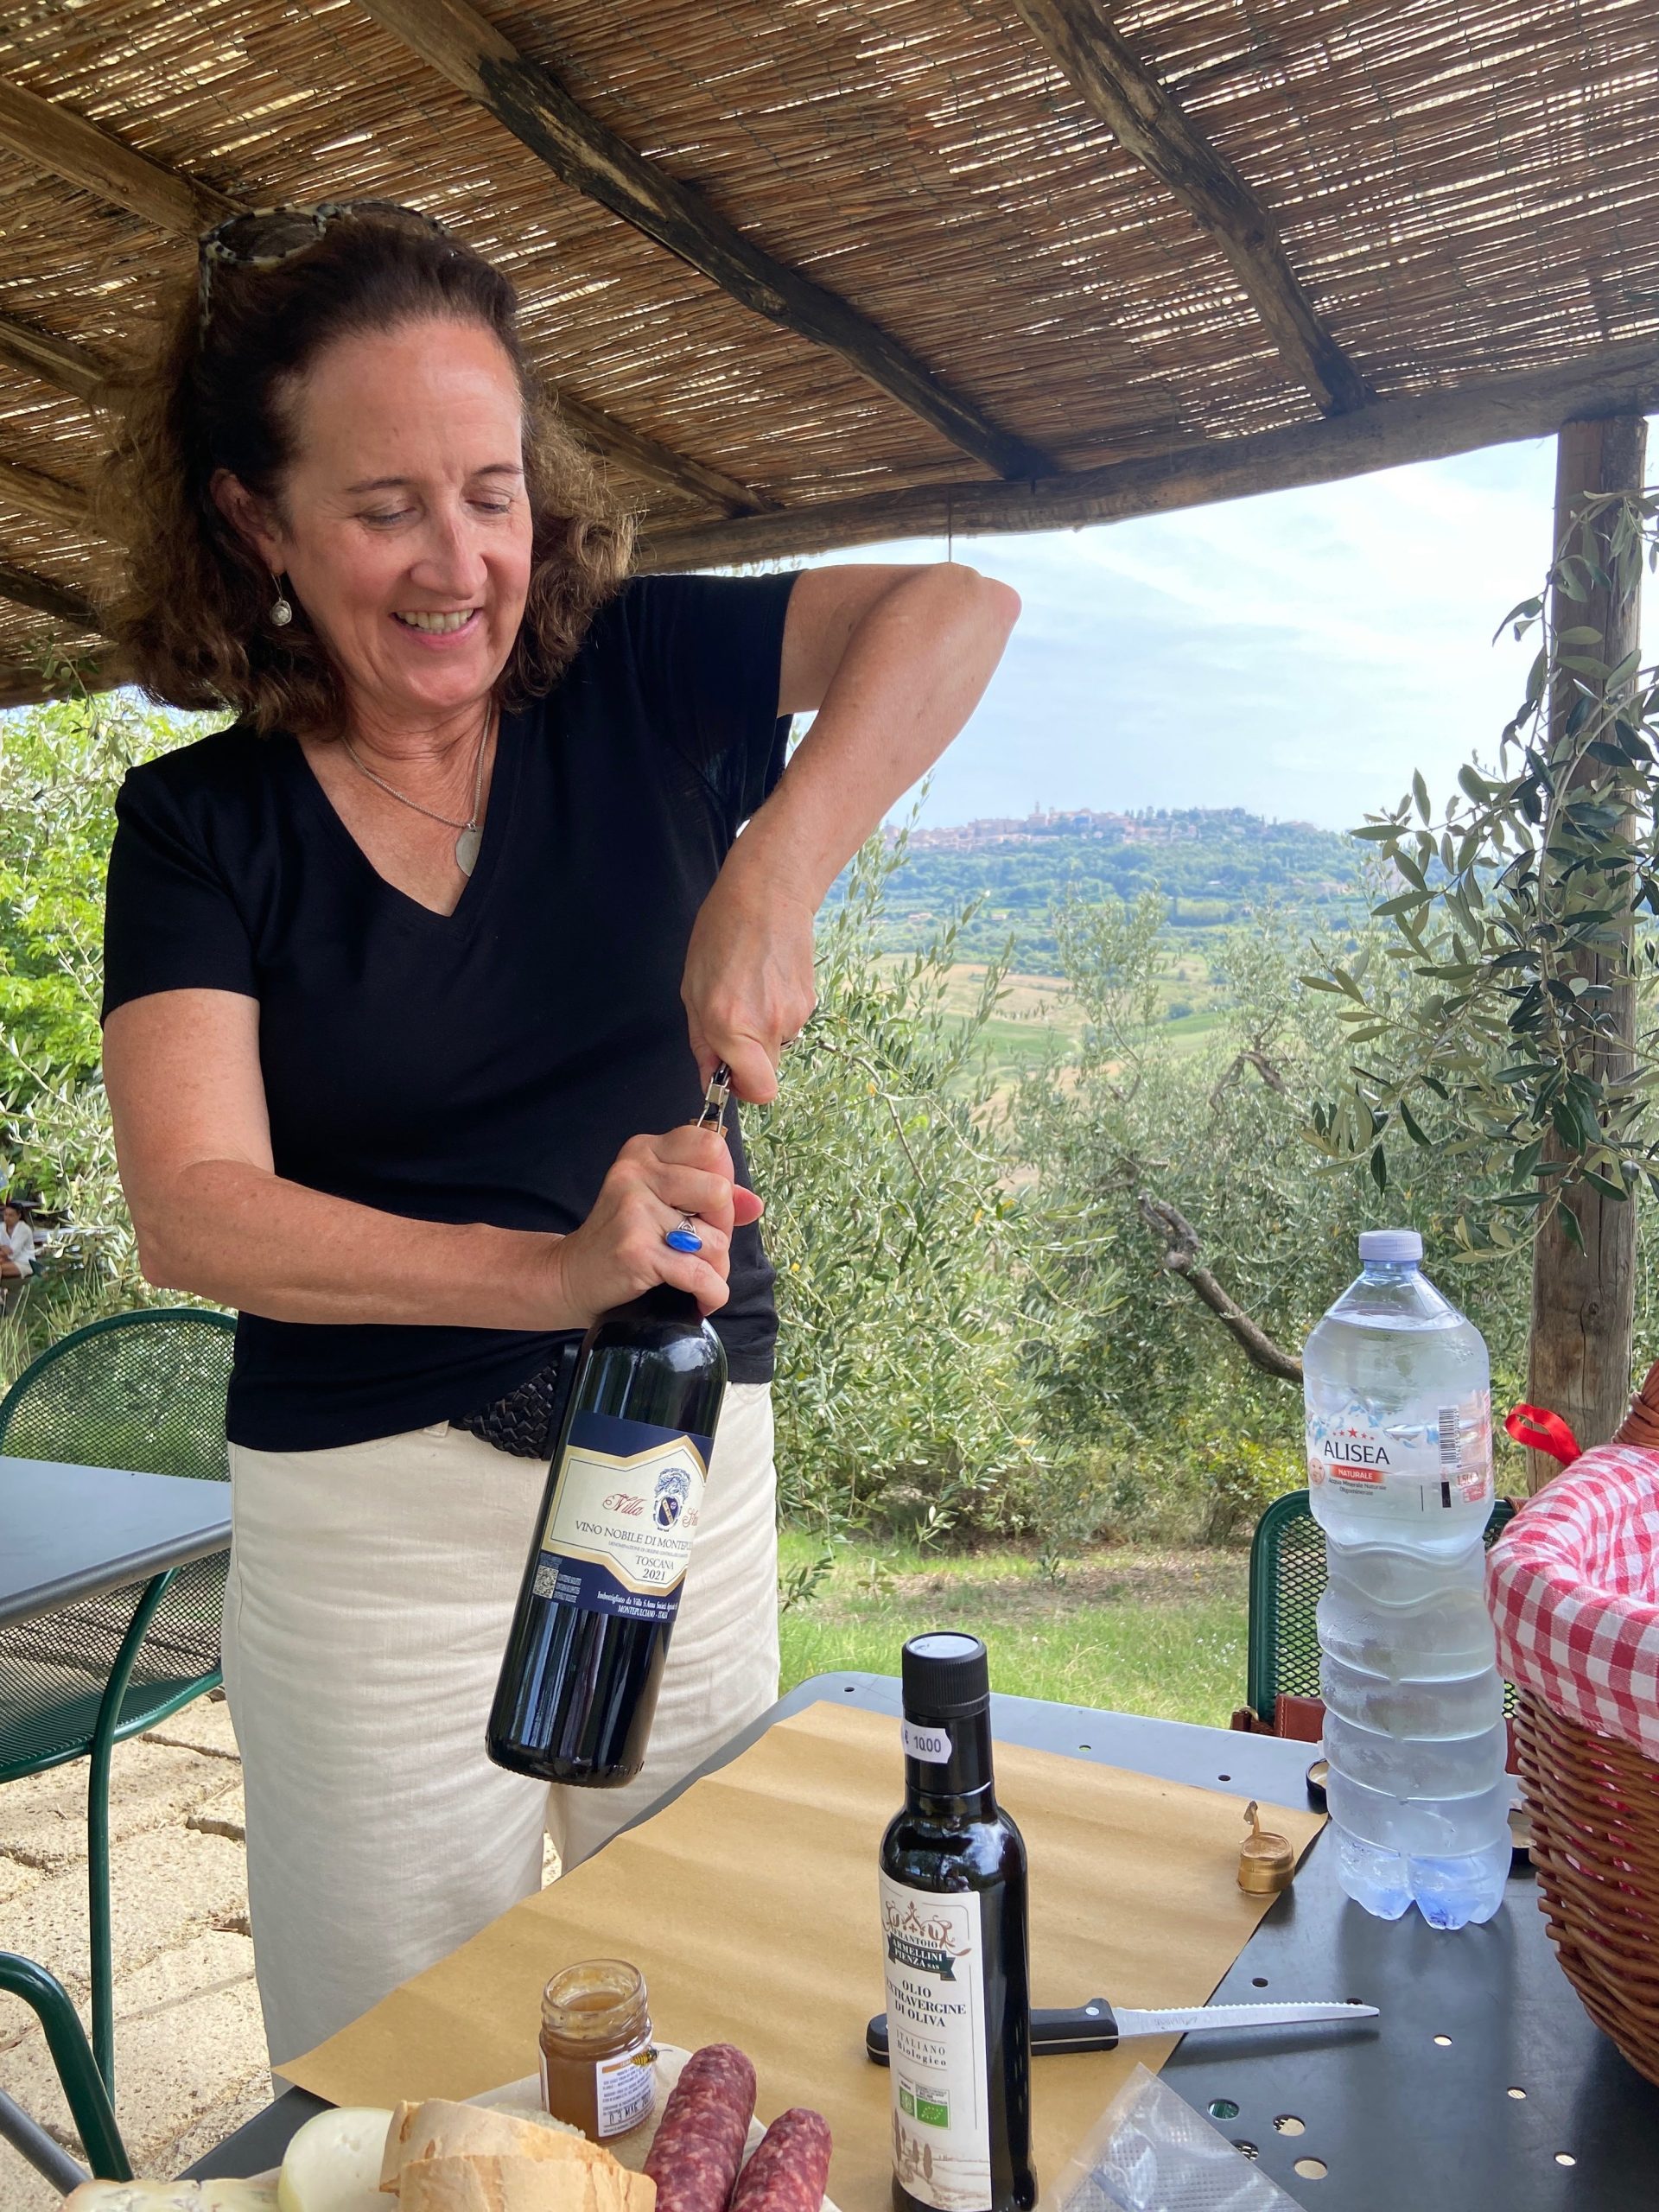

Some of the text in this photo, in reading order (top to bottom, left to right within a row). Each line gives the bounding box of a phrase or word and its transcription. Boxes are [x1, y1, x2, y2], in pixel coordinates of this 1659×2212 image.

[1325, 1440, 1390, 1465] ALISEA
[1338, 1469, 1373, 1480] NATURALE
[1343, 1480, 1363, 1489] Minerale
[1339, 1486, 1374, 1495] Oligominerale
[602, 1494, 646, 1516] Villa
[575, 1521, 602, 1535] VINO
[604, 1527, 644, 1543] NOBILE
[645, 1535, 656, 1547] DI
[636, 1555, 674, 1570] TOSCANA
[643, 1568, 665, 1581] 2021
[618, 1605, 656, 1618] MONTEPULCIANO
[893, 1928, 938, 1948] FRANTOIO
[893, 1939, 943, 1961] ARMELLINI
[894, 1947, 925, 1967] PIENZA
[902, 1980, 931, 1999] OLIO
[895, 1999, 945, 2027] DI OLIVA
[896, 2029, 945, 2056] ITALIANO
[897, 2039, 946, 2066] Biologico
